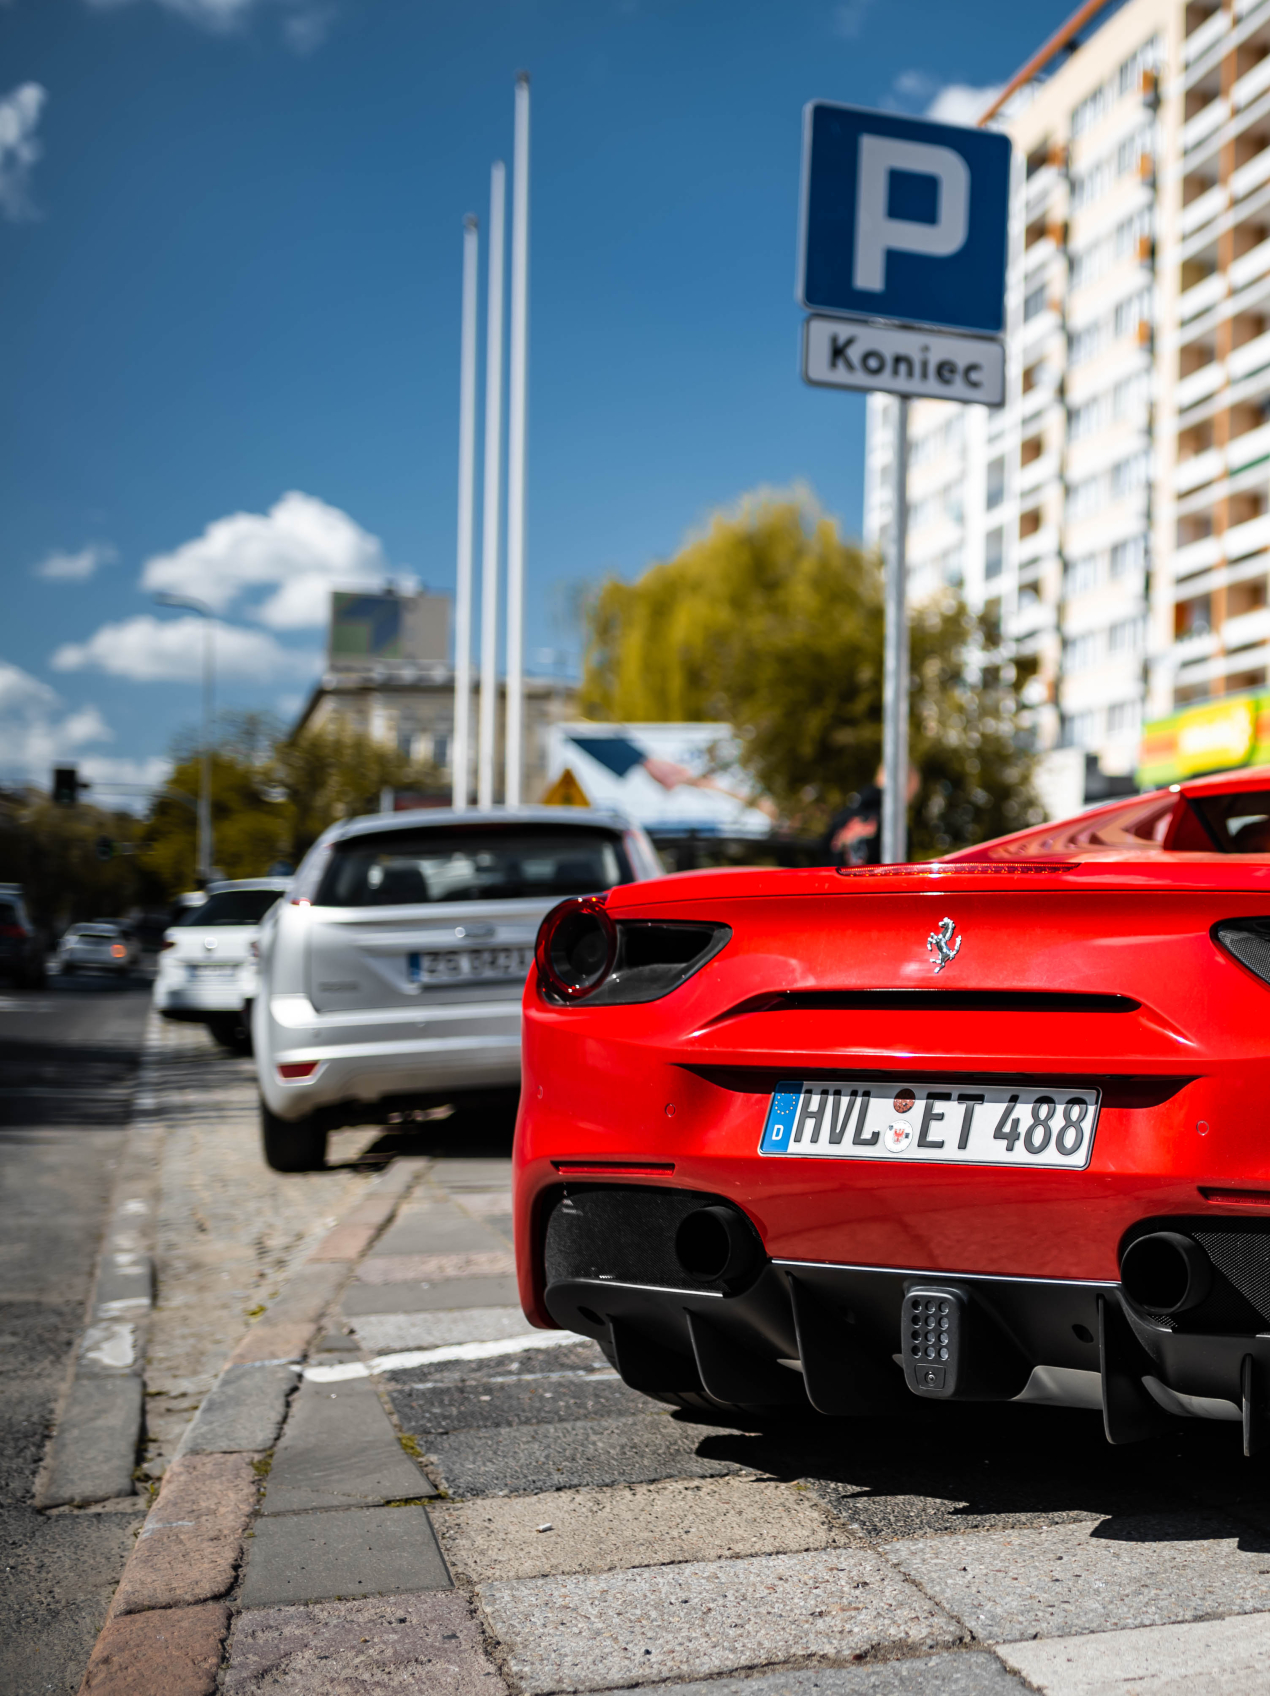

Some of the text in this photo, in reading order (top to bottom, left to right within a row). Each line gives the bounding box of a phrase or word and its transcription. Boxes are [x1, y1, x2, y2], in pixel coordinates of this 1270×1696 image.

[852, 133, 971, 293] P
[829, 333, 984, 389] Koniec
[771, 1124, 784, 1141] D
[794, 1088, 1089, 1156] HVL ET 488
